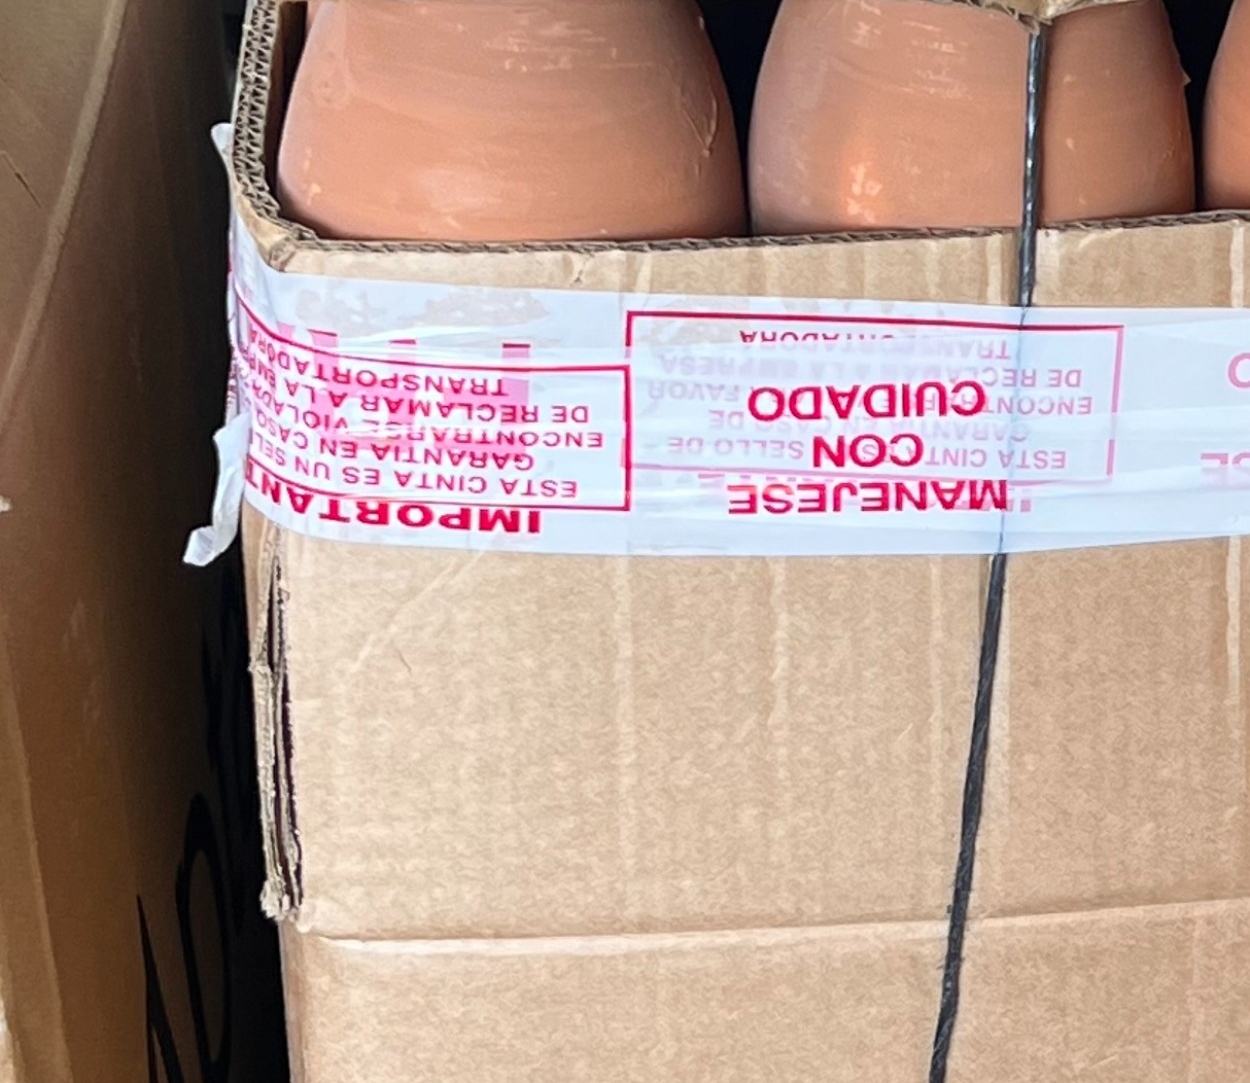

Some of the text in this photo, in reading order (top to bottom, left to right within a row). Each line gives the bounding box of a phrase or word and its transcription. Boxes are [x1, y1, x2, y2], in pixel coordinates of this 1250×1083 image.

[250, 328, 510, 397] TRANSPORTADORA
[1046, 367, 1081, 388] DE
[284, 377, 317, 404] LA
[327, 390, 349, 408] A
[646, 378, 739, 402] FAVOR
[747, 380, 986, 422] CUIDADO
[360, 393, 539, 424] RECLAMAR
[553, 405, 589, 424] DE
[319, 437, 359, 459] EN
[370, 443, 534, 471] GARANTIA
[715, 438, 804, 460] SELLO
[812, 433, 924, 468] CON
[999, 448, 1066, 470] ESTA
[295, 455, 330, 481] UN
[342, 466, 381, 486] ES
[393, 470, 488, 494] CINTA
[499, 479, 577, 498] ESTA
[727, 479, 1008, 516] MANEJESE
